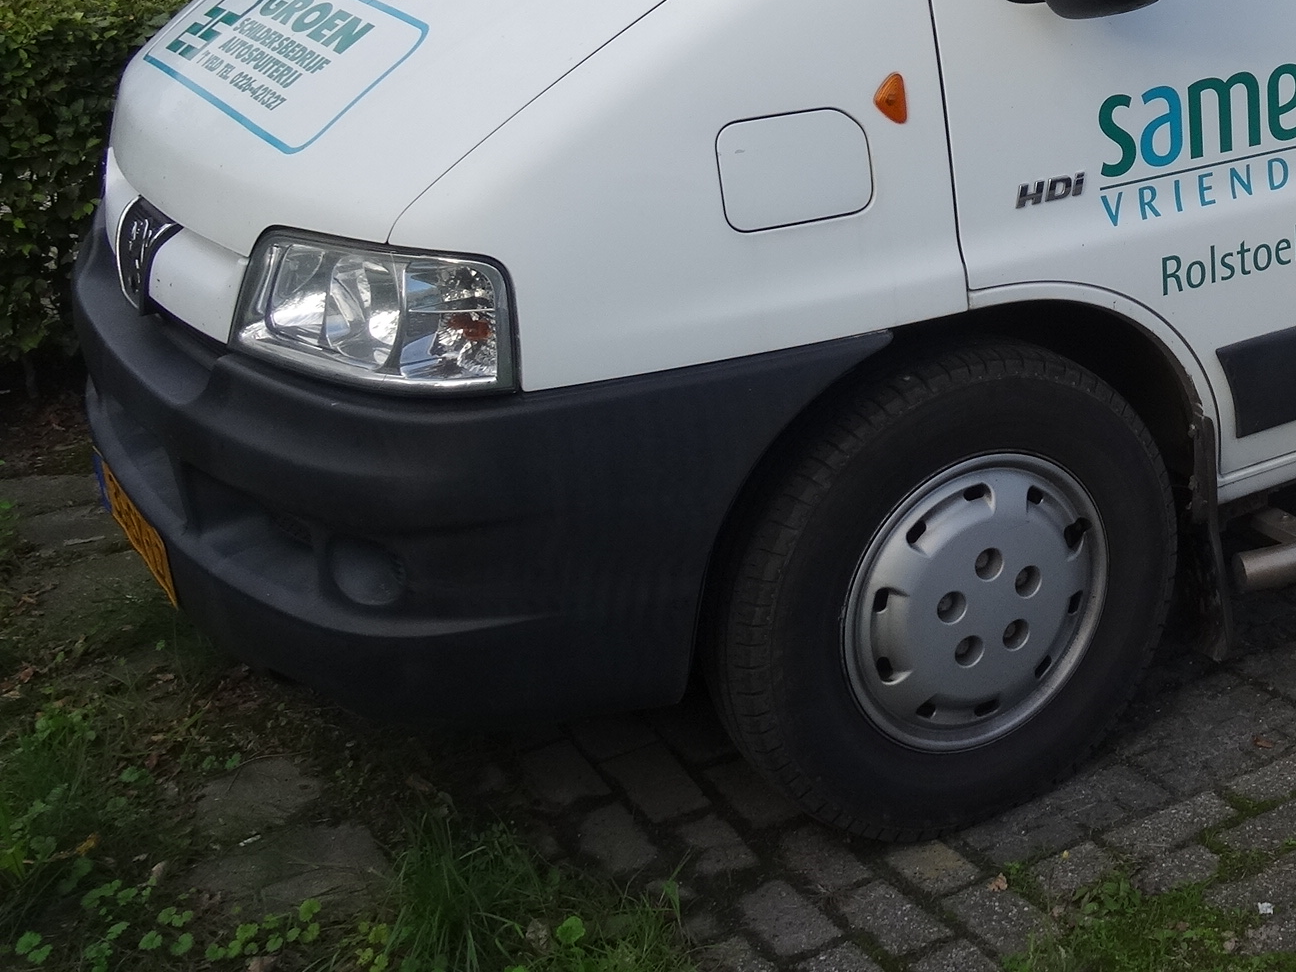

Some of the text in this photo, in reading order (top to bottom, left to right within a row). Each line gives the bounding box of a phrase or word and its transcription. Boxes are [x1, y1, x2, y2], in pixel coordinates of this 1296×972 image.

[218, 36, 304, 89] AUTOSPUITERIJ
[232, 17, 332, 74] SCHILDERSBEDRIJF
[1015, 171, 1086, 210] HDi
